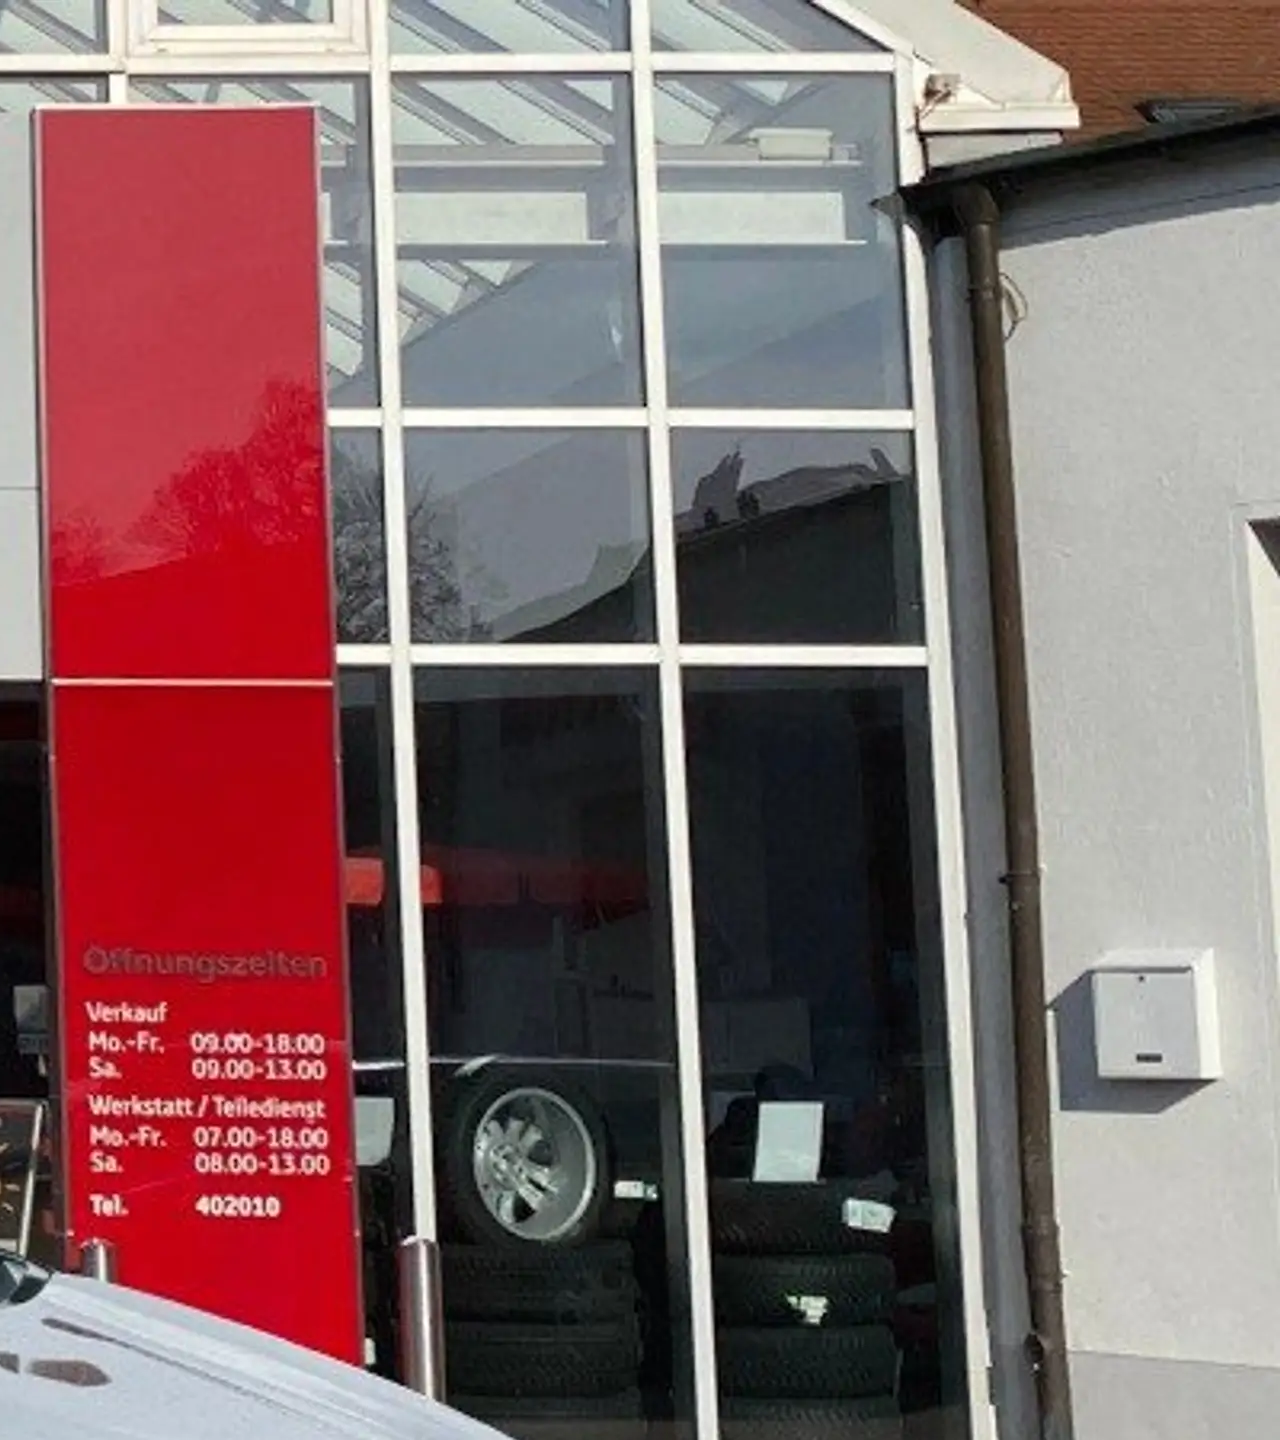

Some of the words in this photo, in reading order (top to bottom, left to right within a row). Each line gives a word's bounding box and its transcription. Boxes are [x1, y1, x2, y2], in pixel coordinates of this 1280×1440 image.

[86, 1002, 168, 1023] Verkauf
[89, 1031, 165, 1053] Mo.-Fr.
[190, 1033, 325, 1055] 09.00-18.00
[89, 1058, 122, 1080] Sa.
[191, 1059, 327, 1081] 09.00-13.00
[88, 1094, 192, 1118] Werkstatt
[198, 1095, 209, 1118] /
[212, 1096, 327, 1120] Teiledienst
[90, 1125, 167, 1147] Mo.-Fr.
[192, 1126, 329, 1149] 07.00-18.00
[90, 1152, 124, 1173] Sa.
[90, 1194, 129, 1216] Tel.
[195, 1196, 281, 1217] 402010
